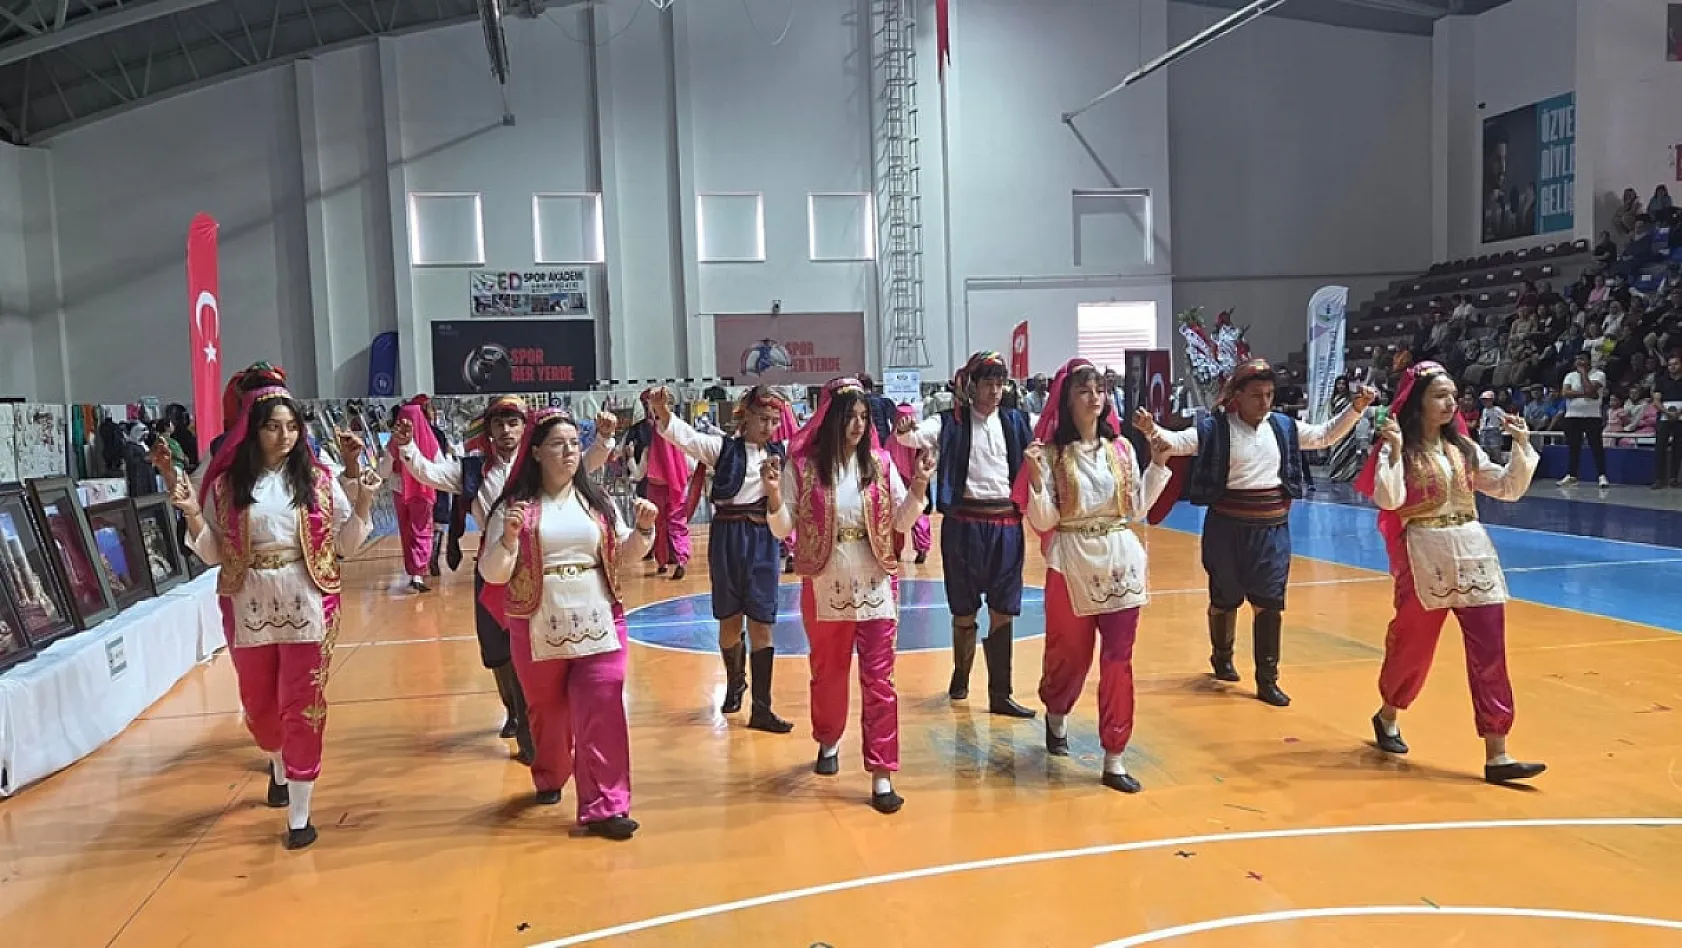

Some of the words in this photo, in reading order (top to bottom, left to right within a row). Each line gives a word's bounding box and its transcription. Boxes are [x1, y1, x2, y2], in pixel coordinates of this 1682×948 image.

[524, 272, 546, 283] SPOR
[511, 347, 544, 365] SPOR
[784, 341, 814, 356] SPOR
[511, 365, 536, 381] HER
[536, 365, 576, 381] YERDE
[806, 357, 841, 373] YERDE
